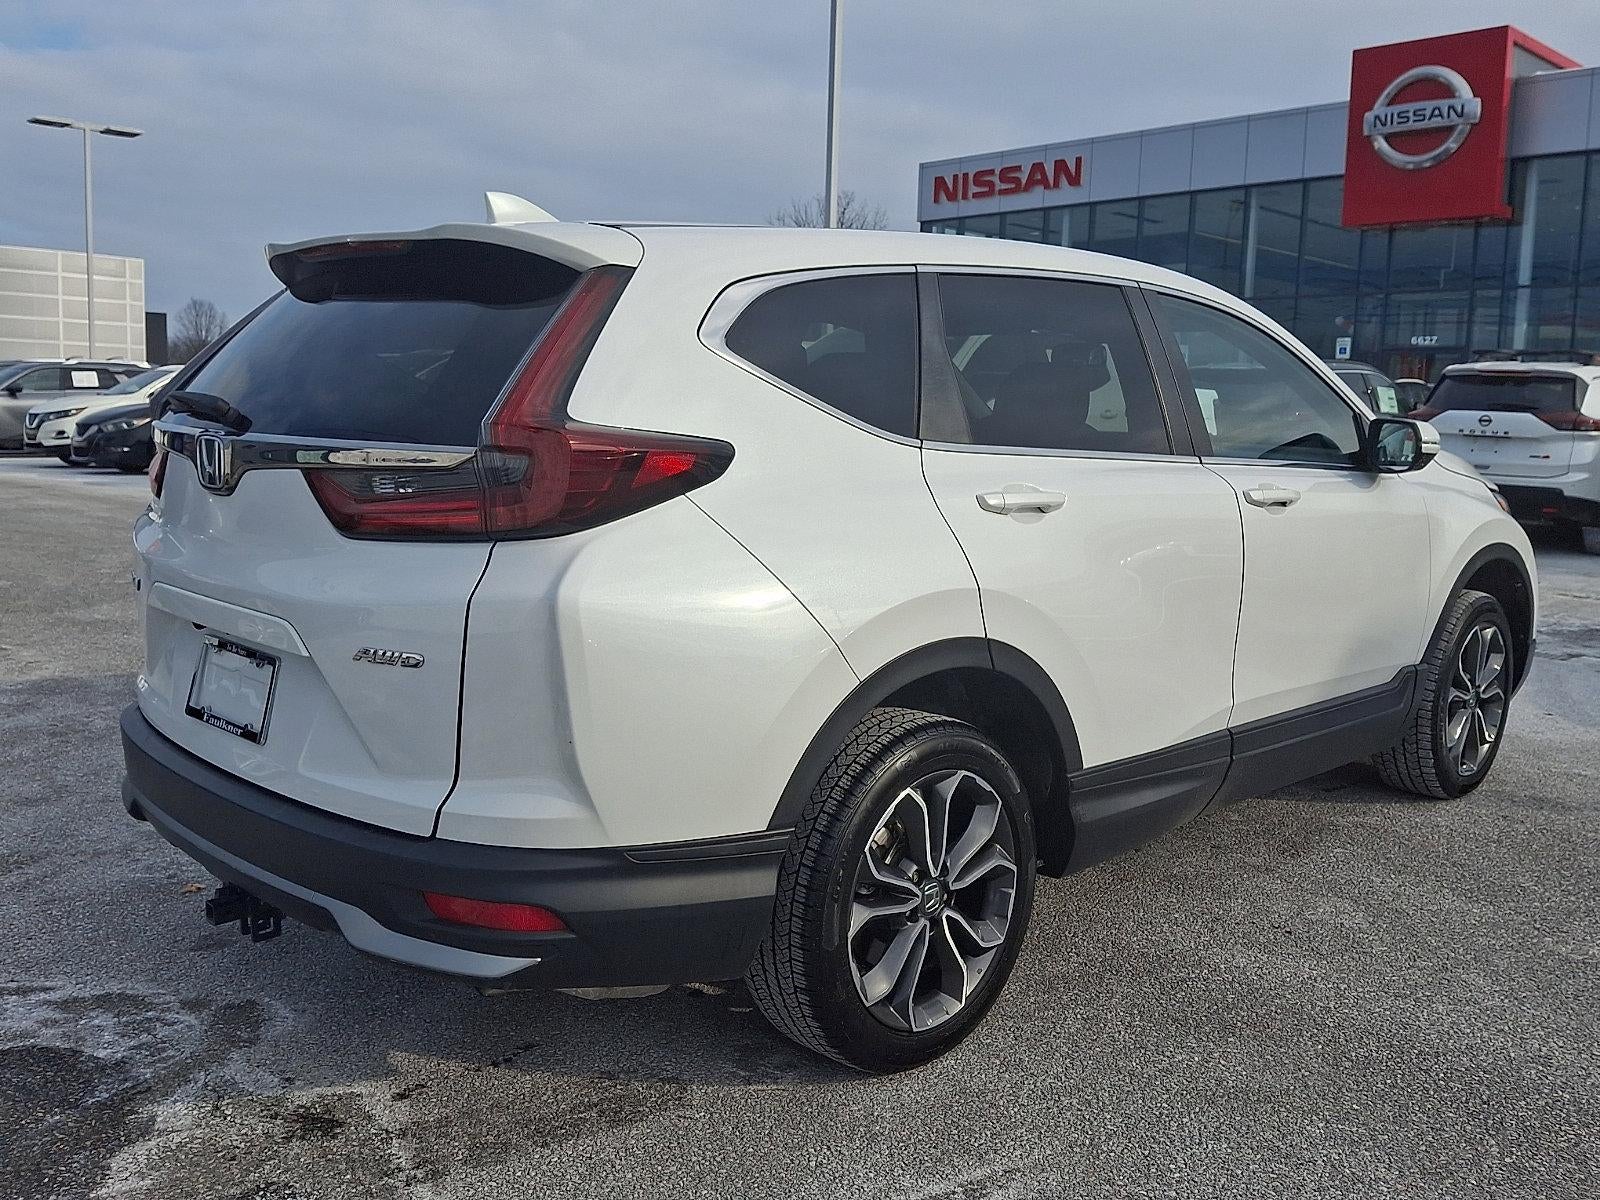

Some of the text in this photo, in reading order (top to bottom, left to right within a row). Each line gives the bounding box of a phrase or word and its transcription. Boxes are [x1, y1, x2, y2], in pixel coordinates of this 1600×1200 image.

[1373, 104, 1465, 128] NISSAN
[933, 156, 1083, 204] NISSAN
[1410, 335, 1438, 345] 6627
[353, 646, 425, 669] AWD
[203, 712, 243, 736] Faulkner
